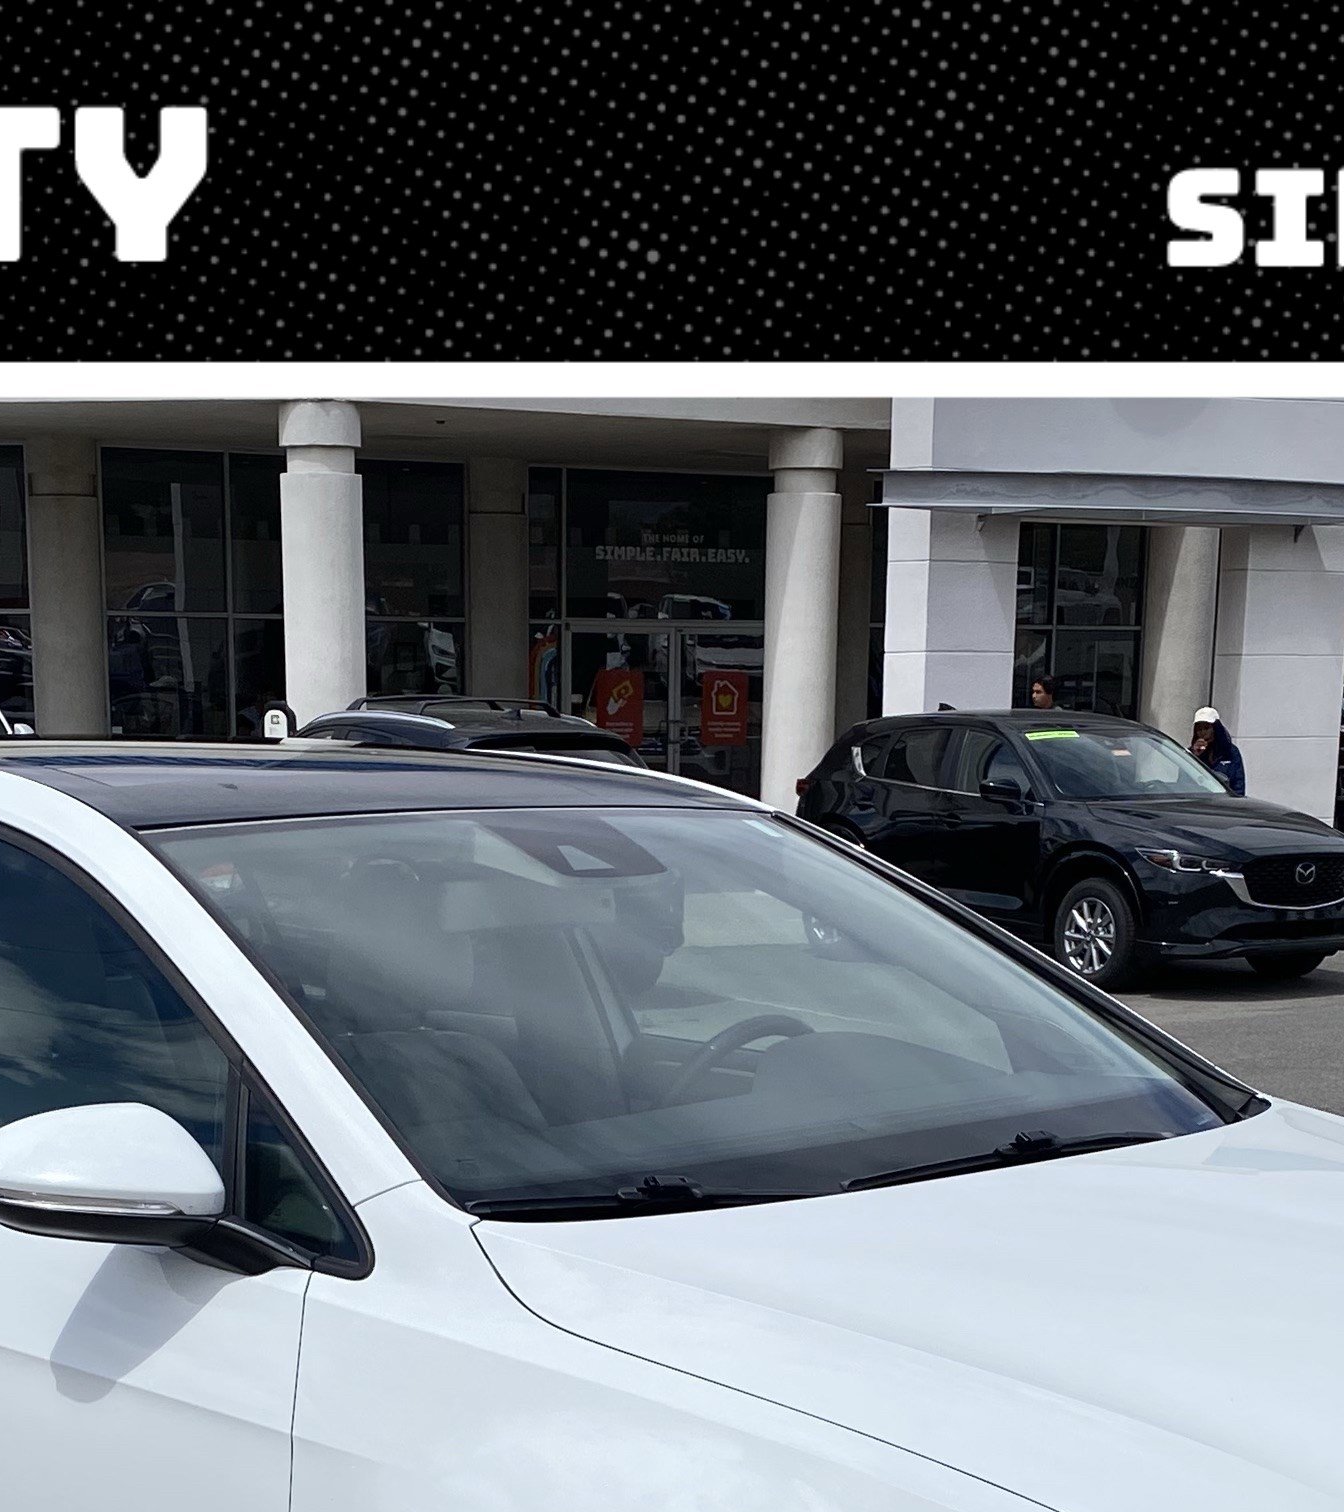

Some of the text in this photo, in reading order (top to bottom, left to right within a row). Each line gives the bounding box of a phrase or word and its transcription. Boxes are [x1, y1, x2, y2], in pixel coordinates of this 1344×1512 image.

[642, 533, 705, 543] THE HOME OF
[594, 545, 751, 564] SIMPLE.FAIR.EASY.
